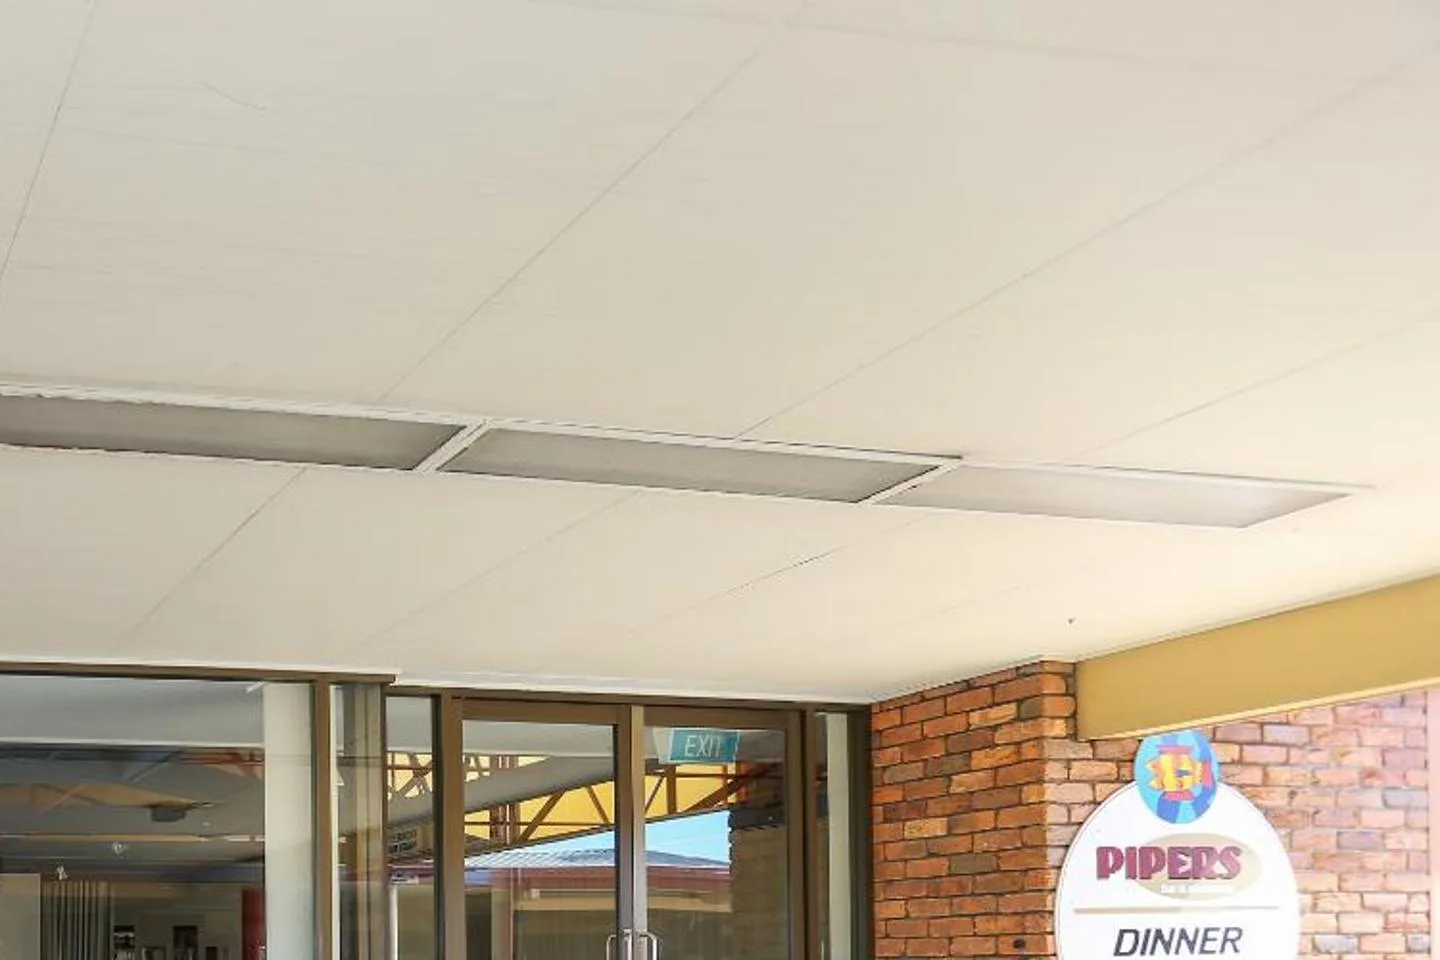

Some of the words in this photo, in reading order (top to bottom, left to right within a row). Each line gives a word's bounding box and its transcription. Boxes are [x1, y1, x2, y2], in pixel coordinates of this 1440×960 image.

[684, 734, 721, 757] EXIT
[1096, 846, 1242, 880] PIPERS
[1113, 927, 1243, 956] DINNER
